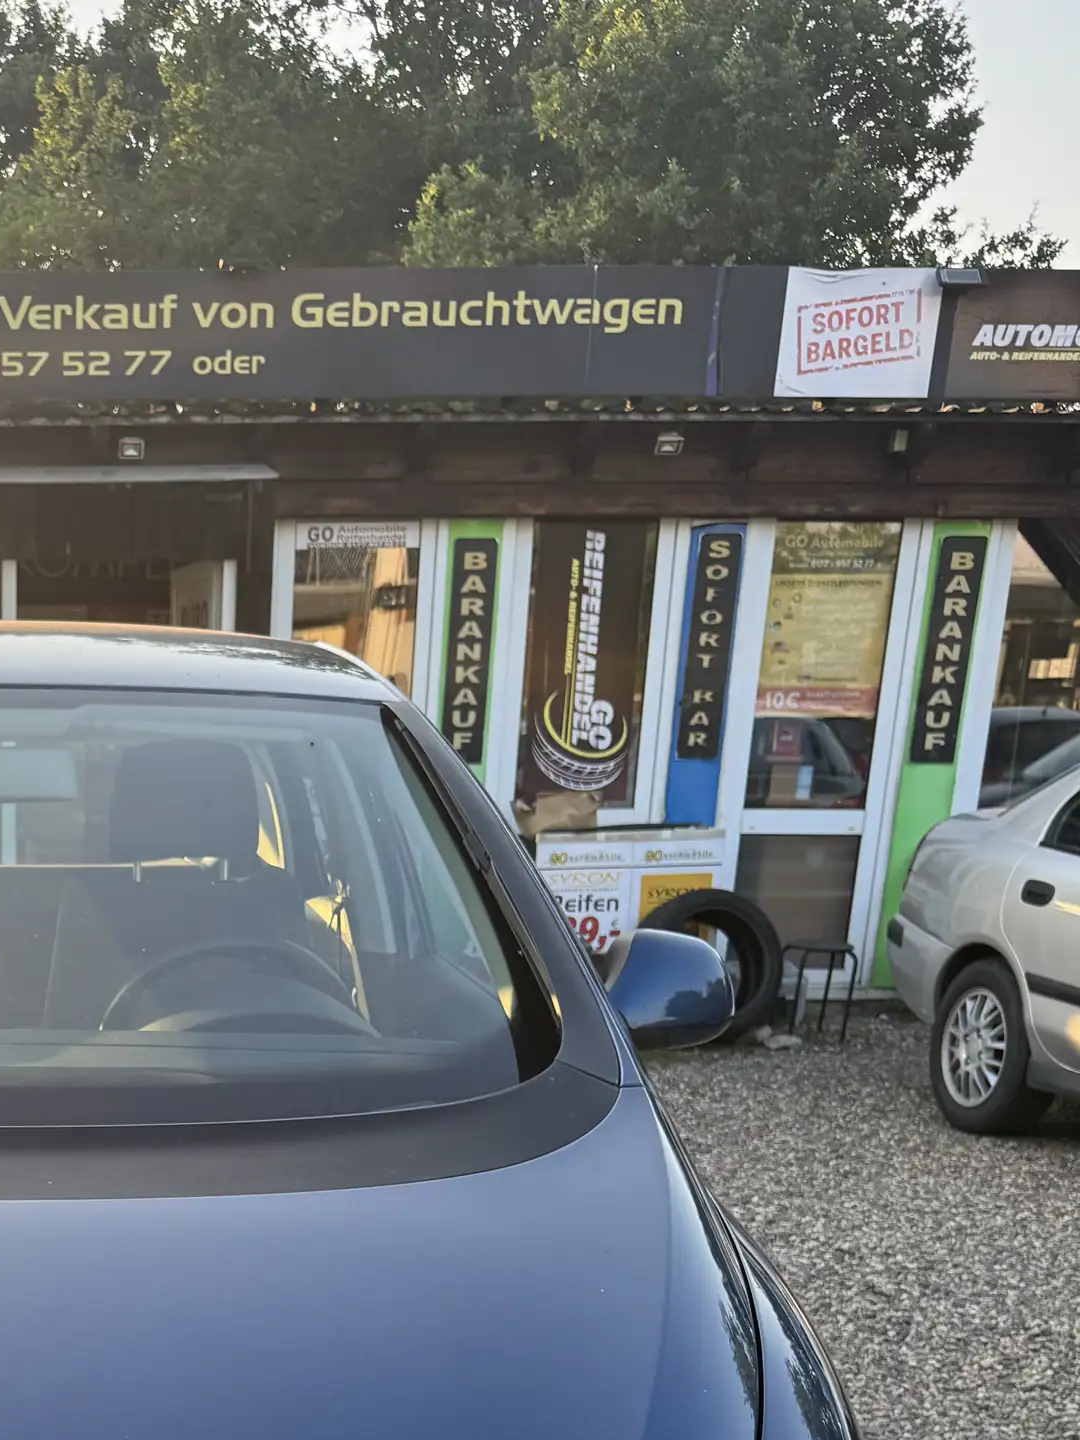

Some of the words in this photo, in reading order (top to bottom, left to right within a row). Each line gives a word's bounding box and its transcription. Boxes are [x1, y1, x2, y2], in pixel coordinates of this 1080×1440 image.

[192, 300, 275, 329] von
[291, 290, 683, 334] Gebrauchtwagen
[812, 301, 905, 334] SOFORT
[806, 328, 914, 364] BARGELD
[969, 351, 1001, 360] AUTO-
[1001, 351, 1010, 360] &
[972, 324, 1080, 347] AUTOM
[62, 350, 112, 377] 52
[124, 349, 173, 376] 77
[192, 349, 266, 376] oder
[308, 526, 334, 542] GO
[697, 540, 731, 668] SOFORT
[452, 552, 488, 751] BARANKAUF
[571, 530, 607, 747] REIFENHANDEL
[924, 551, 974, 751] BARANKAUF
[589, 699, 614, 750] GO
[687, 689, 713, 747] BAR
[567, 916, 620, 951] 9,-
